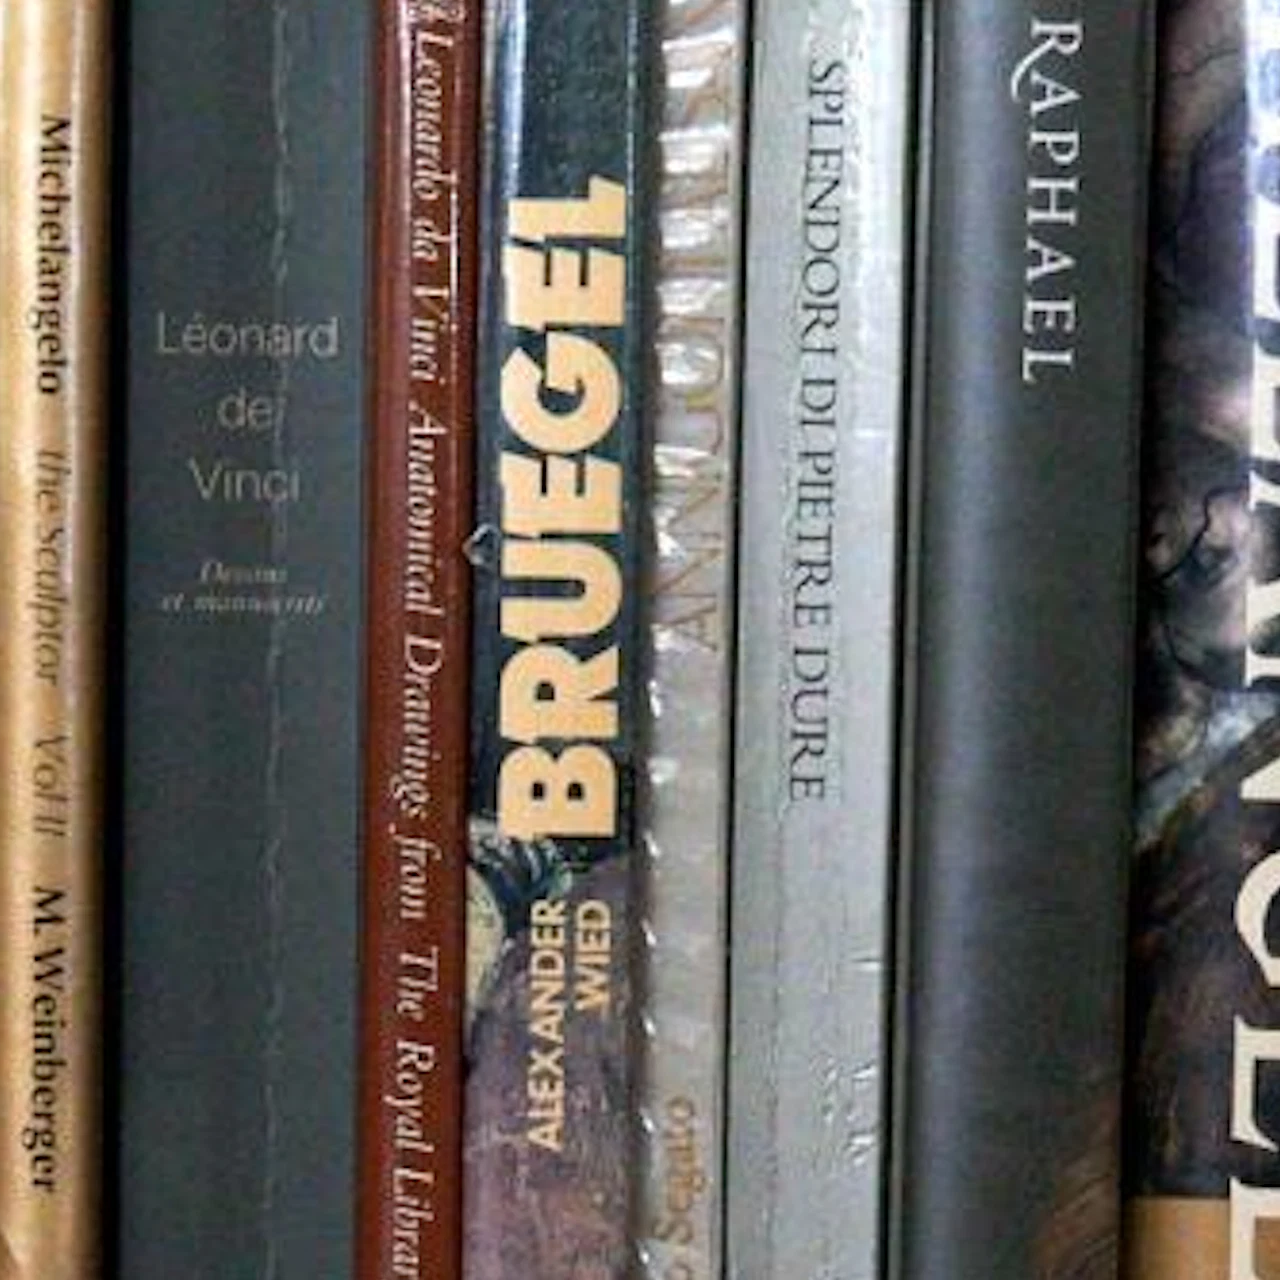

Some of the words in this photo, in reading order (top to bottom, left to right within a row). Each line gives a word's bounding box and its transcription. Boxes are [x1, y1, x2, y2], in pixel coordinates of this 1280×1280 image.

[410, 29, 454, 202] Leonardo
[28, 115, 73, 396] Michelangelo
[410, 219, 450, 260] da
[799, 57, 844, 356] SPLENDORI
[1010, 19, 1085, 384] RAPHAEL
[158, 311, 341, 358] Léonard
[409, 285, 450, 387] Vinci
[218, 387, 273, 427] de
[799, 377, 838, 431] DI
[35, 448, 72, 513] the
[189, 457, 301, 502] Vinci
[404, 402, 448, 618] Anatomical
[497, 176, 626, 842] BRUEGEL
[791, 449, 835, 627] PIETRE
[26, 525, 70, 688] Sculptor
[390, 634, 444, 818] Drawings
[788, 644, 829, 804] DURE
[32, 885, 66, 935] M.
[389, 823, 442, 920] from
[396, 946, 440, 1020] The
[574, 899, 613, 1011] WIED
[22, 946, 67, 1194] Weinberger
[523, 899, 570, 1152] ALEXANDER
[383, 1039, 437, 1153] Royal
